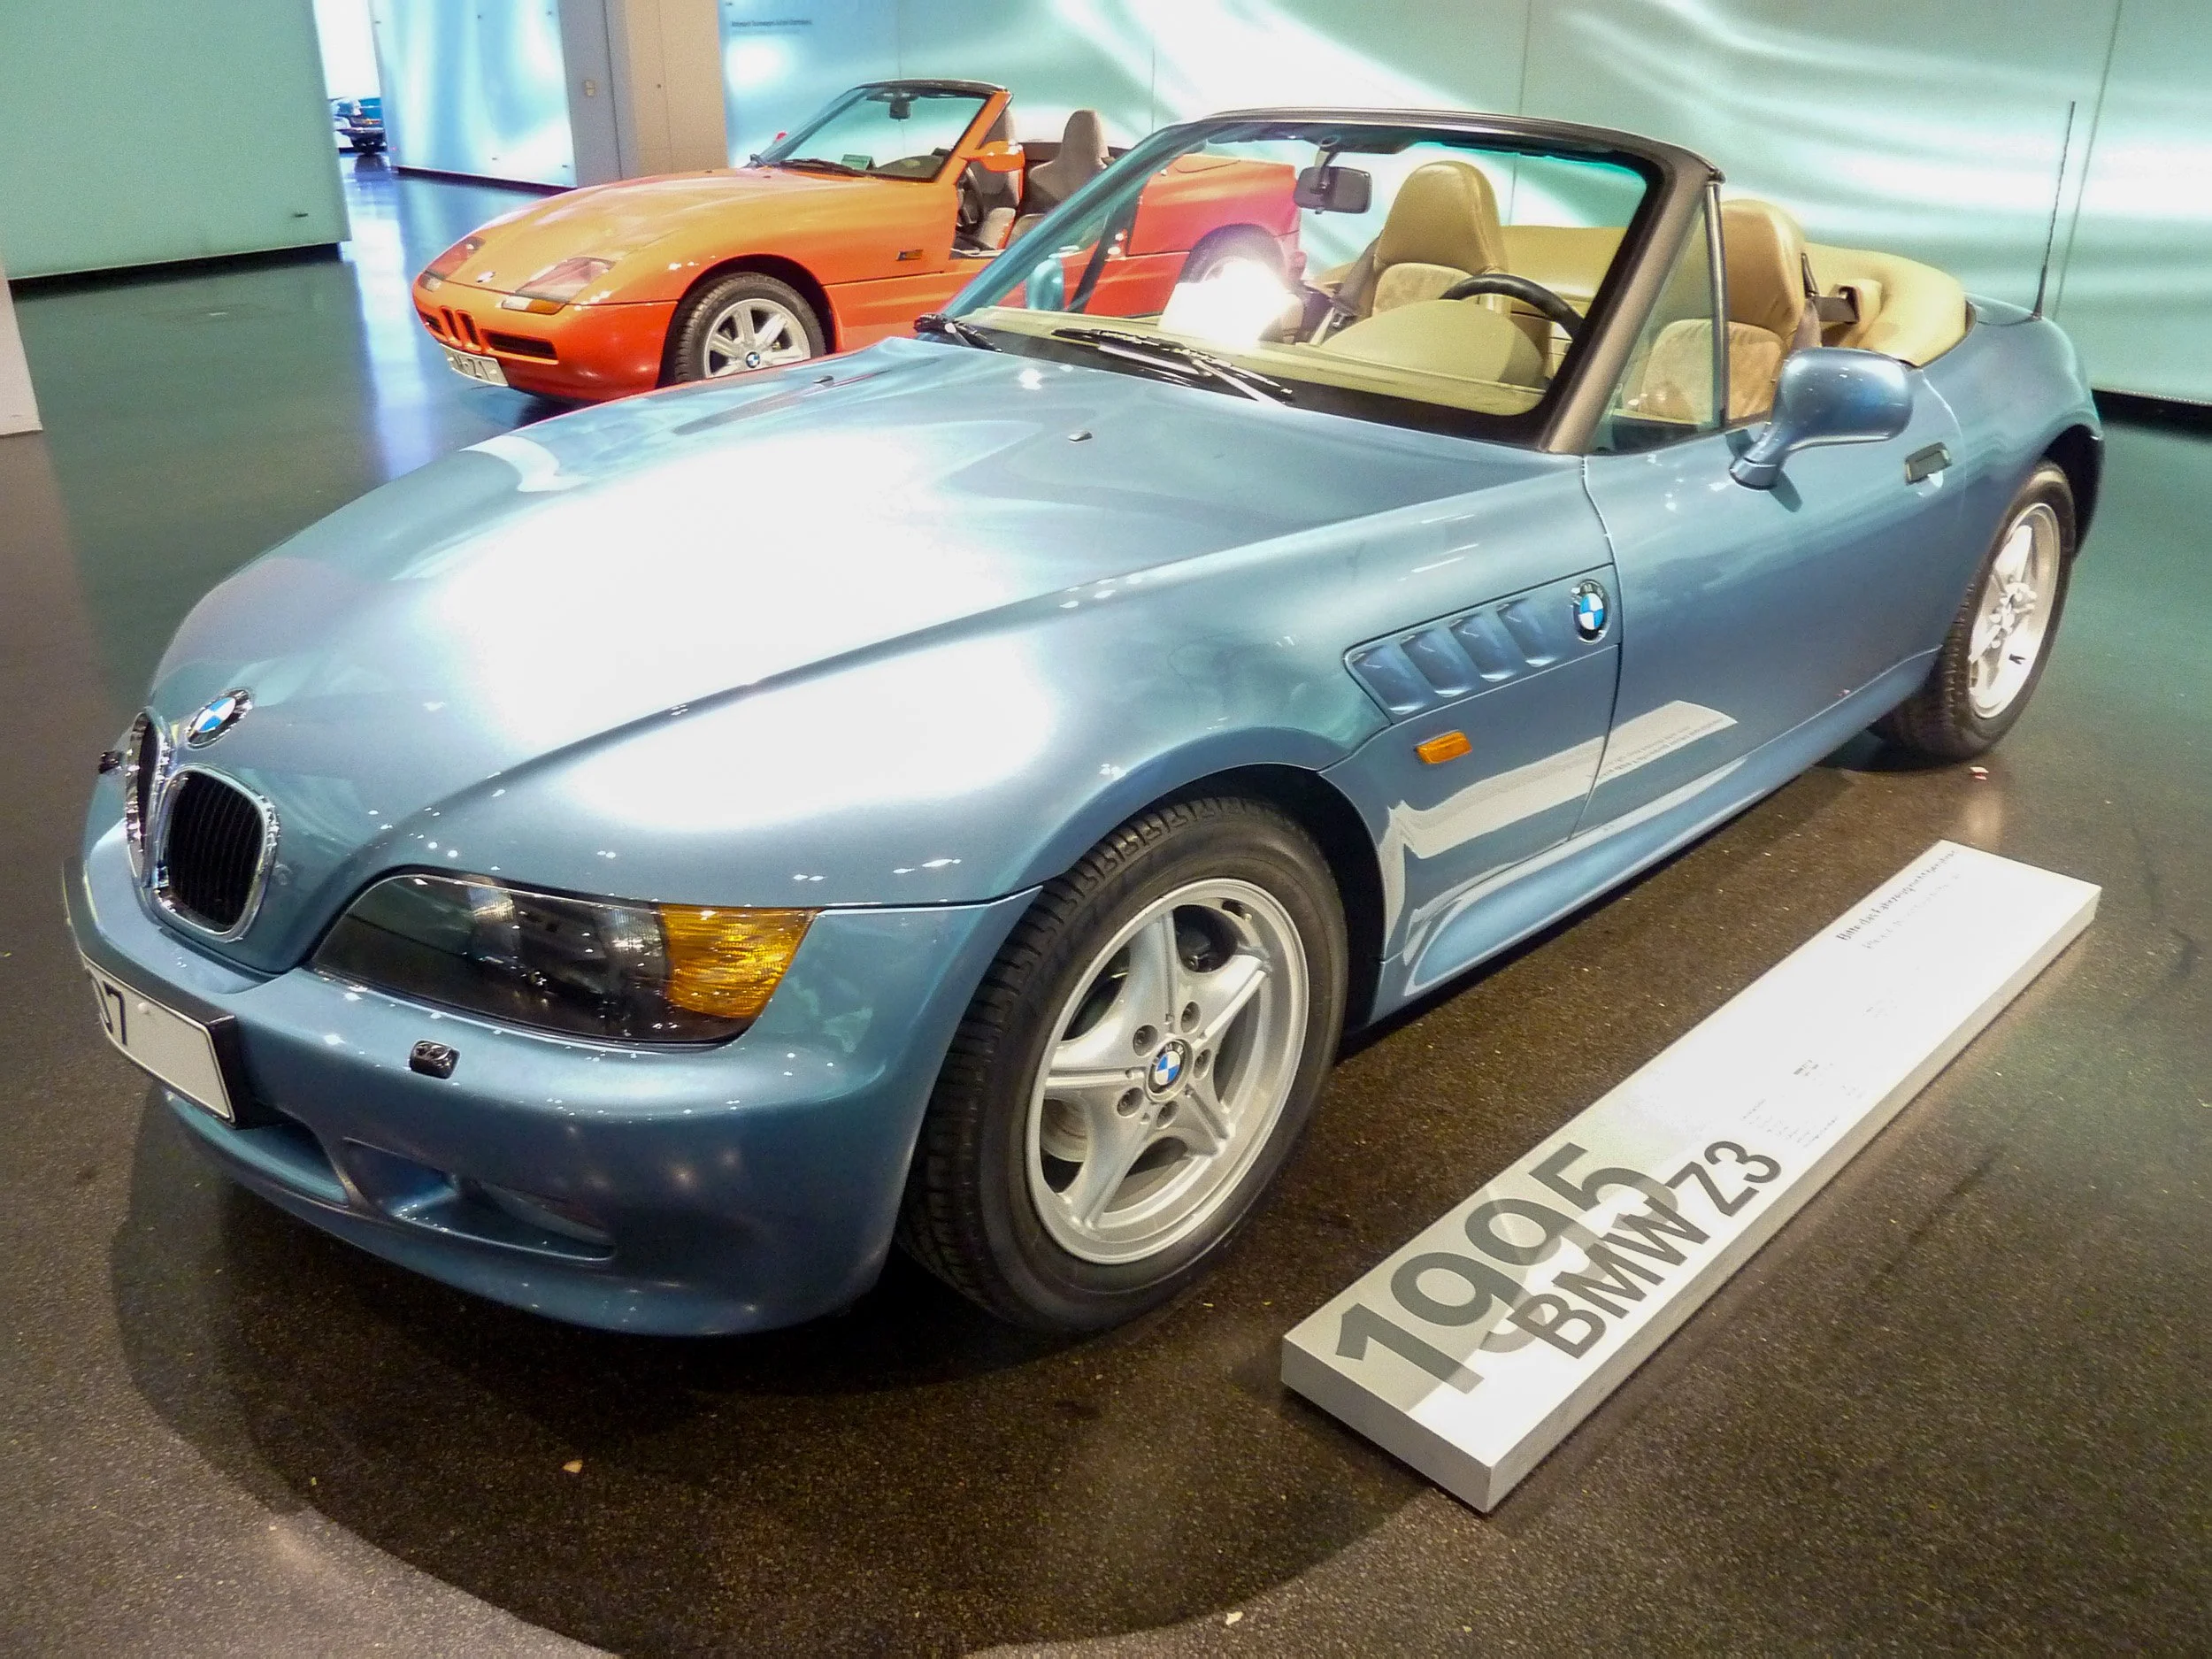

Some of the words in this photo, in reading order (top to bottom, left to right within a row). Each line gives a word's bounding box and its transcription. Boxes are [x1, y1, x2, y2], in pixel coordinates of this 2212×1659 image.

[1335, 1142, 1679, 1394] 1995
[1508, 1195, 1710, 1359] BMW
[1666, 1140, 1782, 1217] Z3
